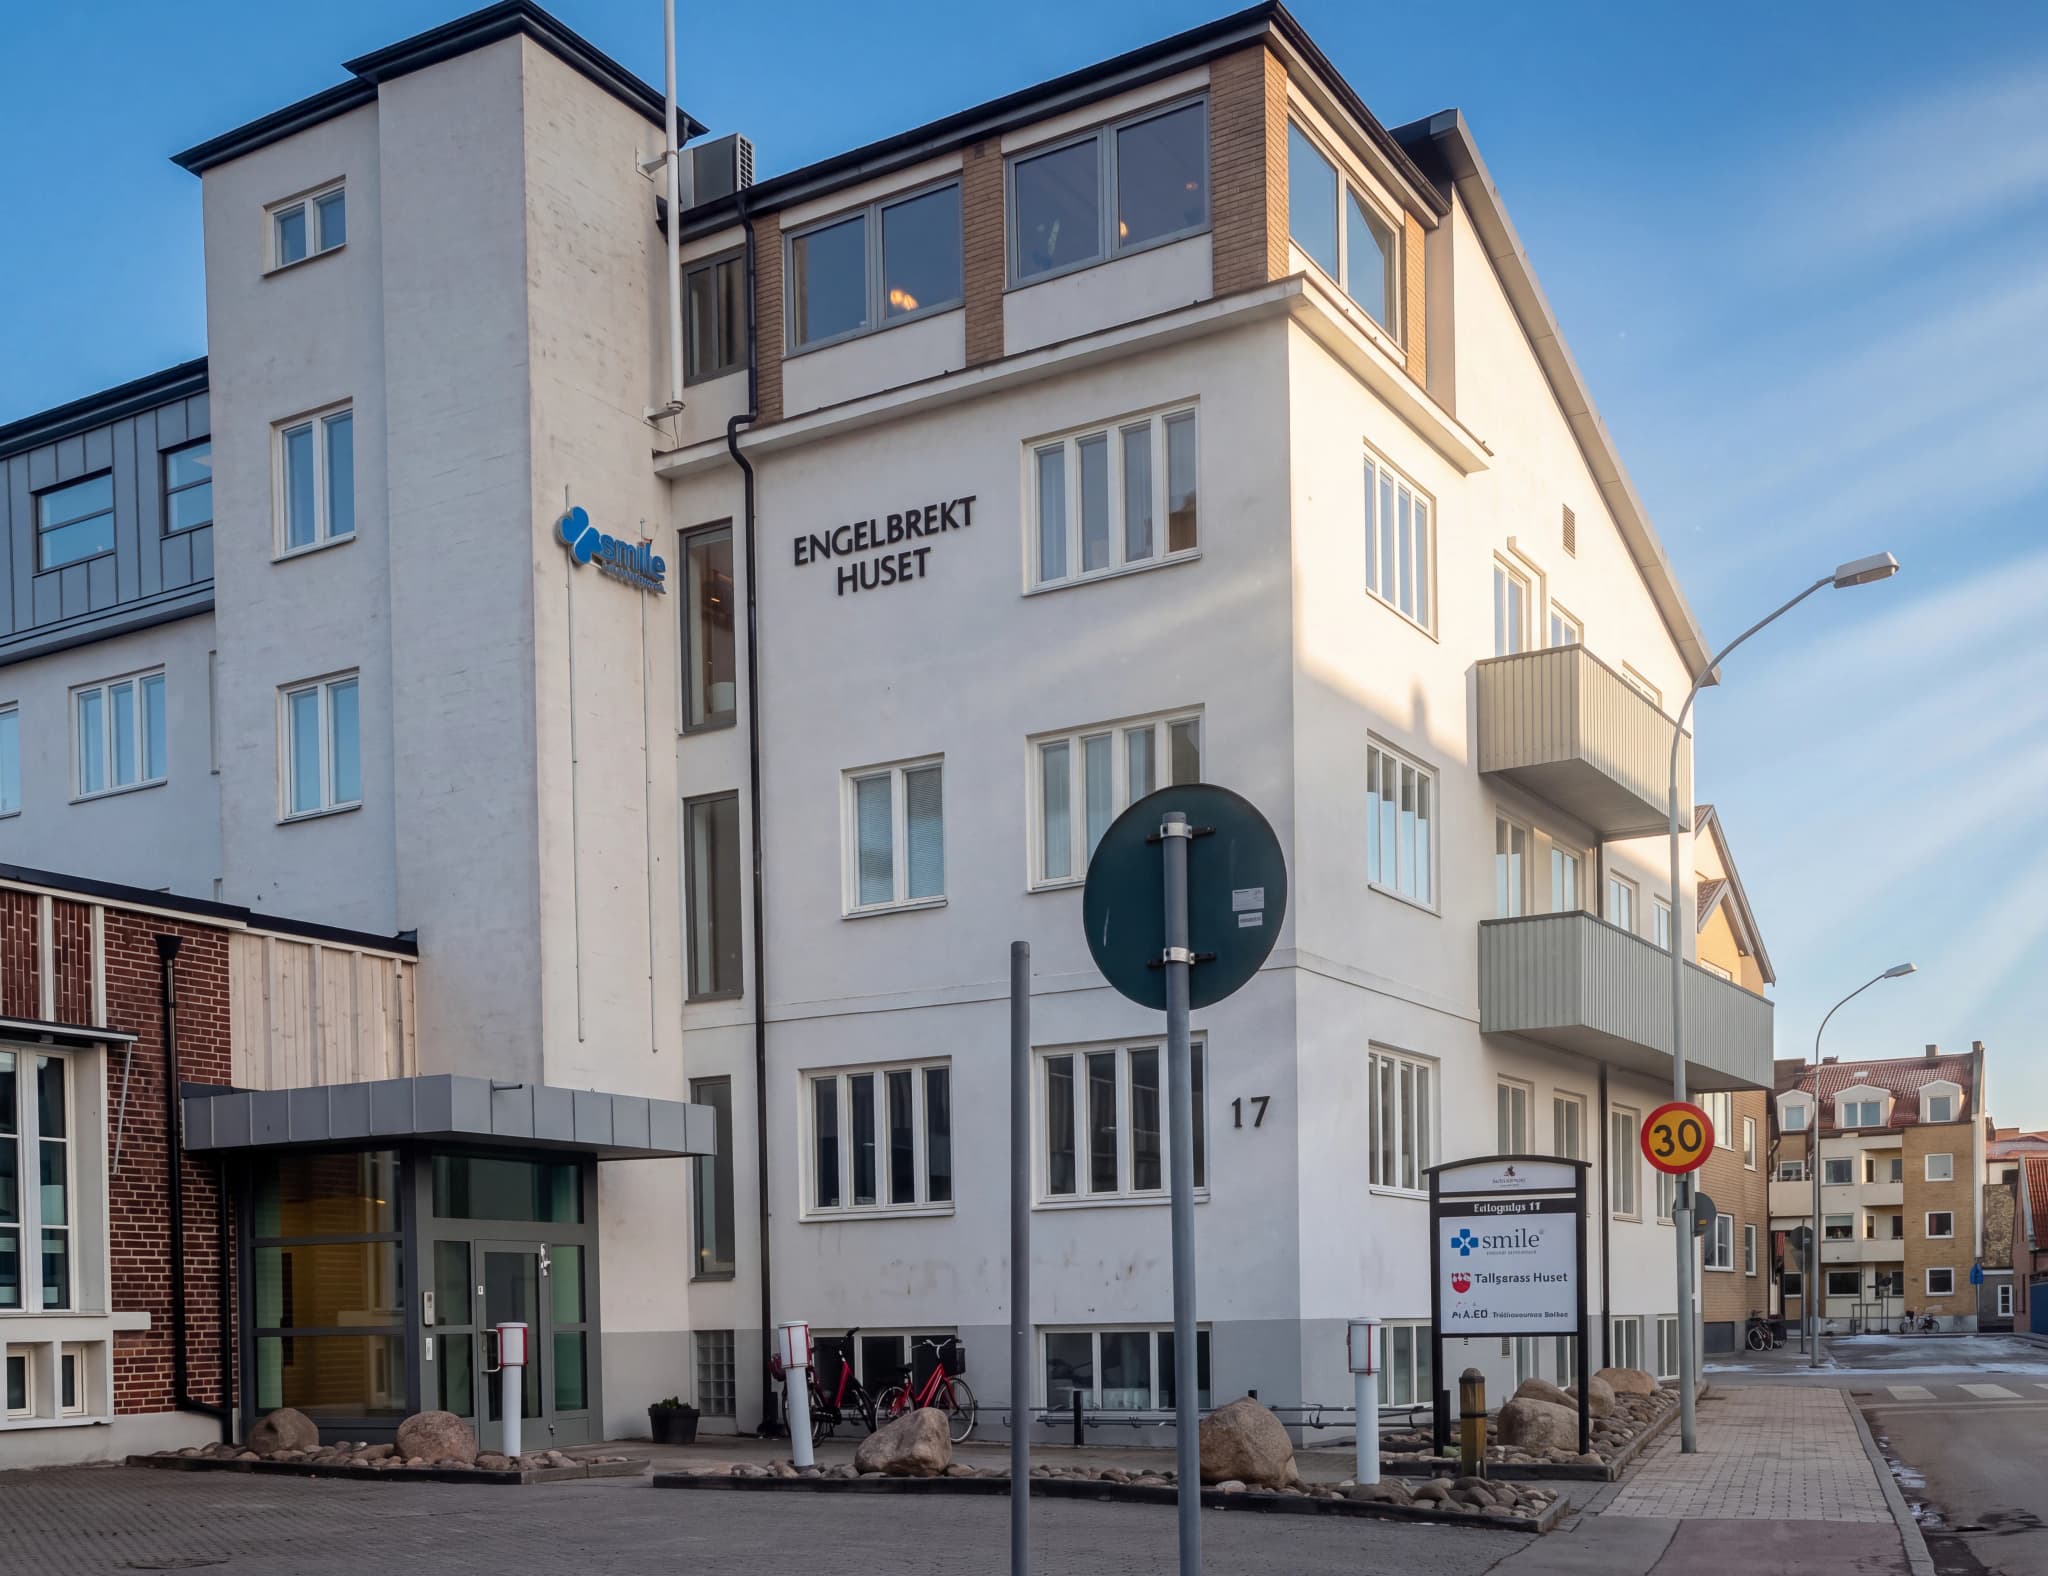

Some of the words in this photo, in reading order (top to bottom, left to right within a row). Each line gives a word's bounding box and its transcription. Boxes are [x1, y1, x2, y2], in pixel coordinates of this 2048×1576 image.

[794, 495, 976, 566] ENGELBREKT
[599, 534, 666, 581] smile
[837, 547, 931, 596] HUSET
[1231, 1095, 1270, 1128] 17
[1654, 1119, 1702, 1157] 30
[1482, 1228, 1540, 1249] smile
[1533, 1272, 1568, 1283] Huset
